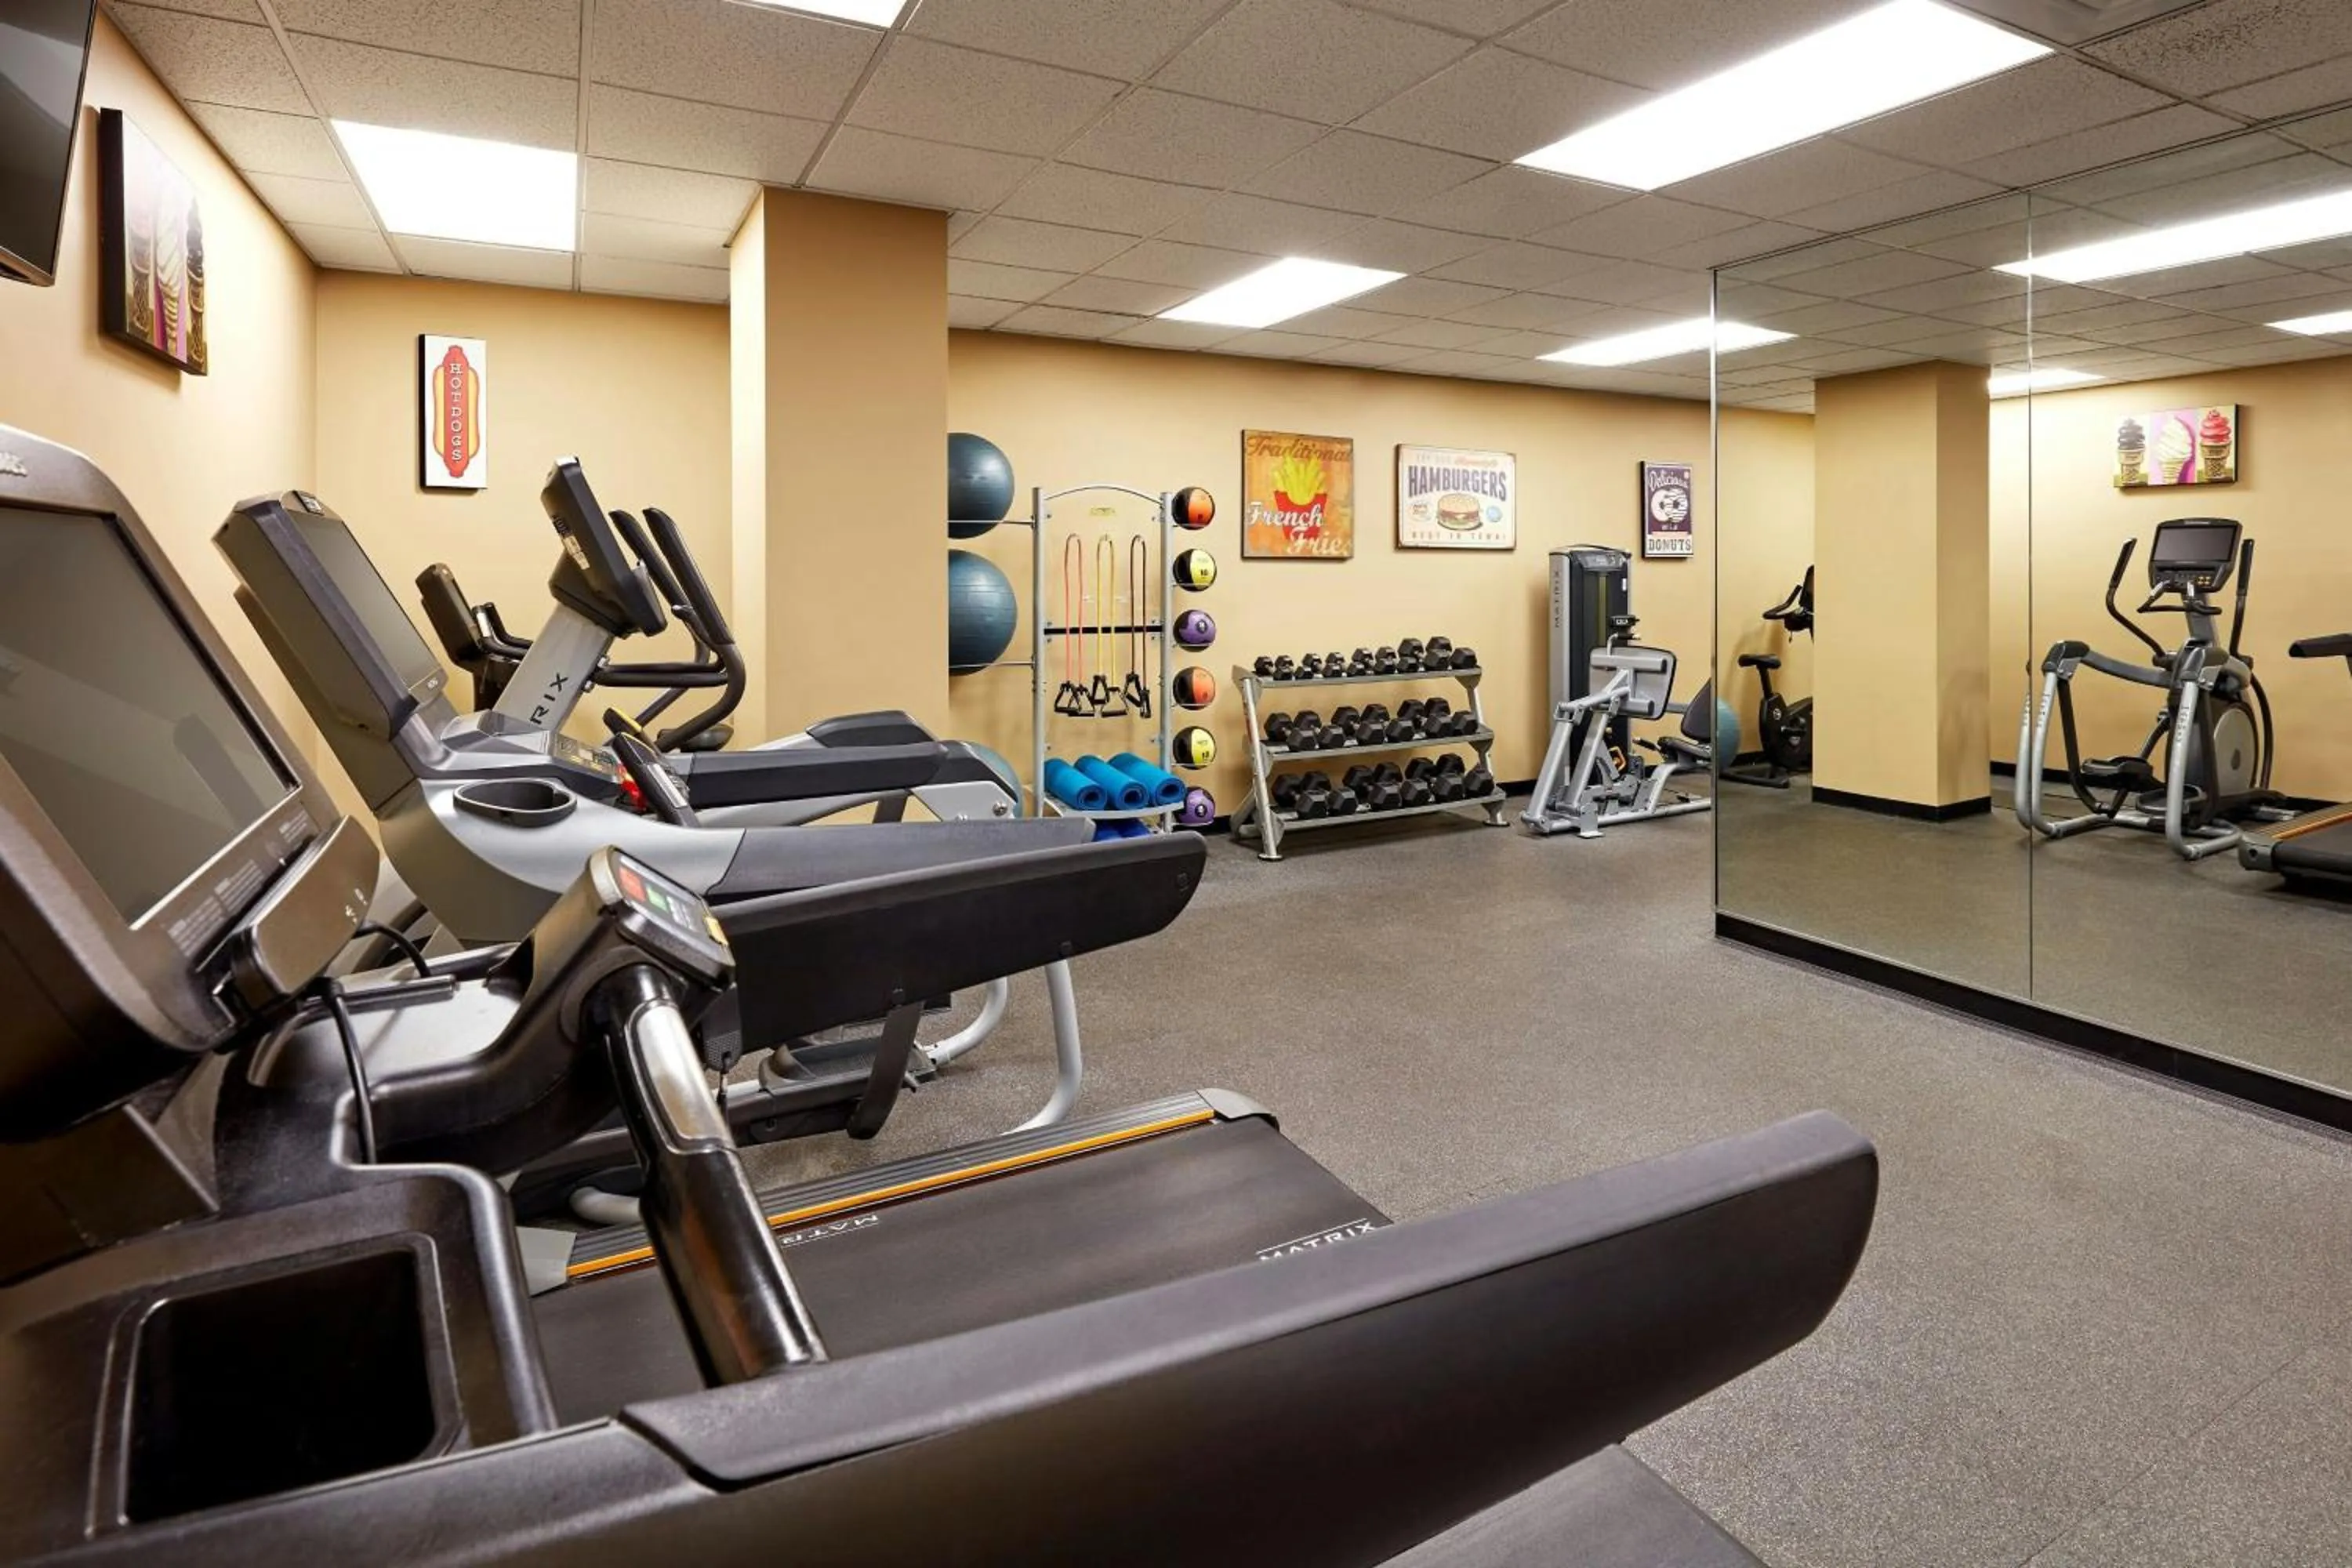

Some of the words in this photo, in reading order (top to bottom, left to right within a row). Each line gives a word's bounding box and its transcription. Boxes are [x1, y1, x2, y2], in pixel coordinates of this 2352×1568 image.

[451, 407, 462, 461] DOGS
[1408, 465, 1507, 502] HAMBURGERS
[1247, 501, 1323, 528] French
[1649, 539, 1691, 551] DONUTS
